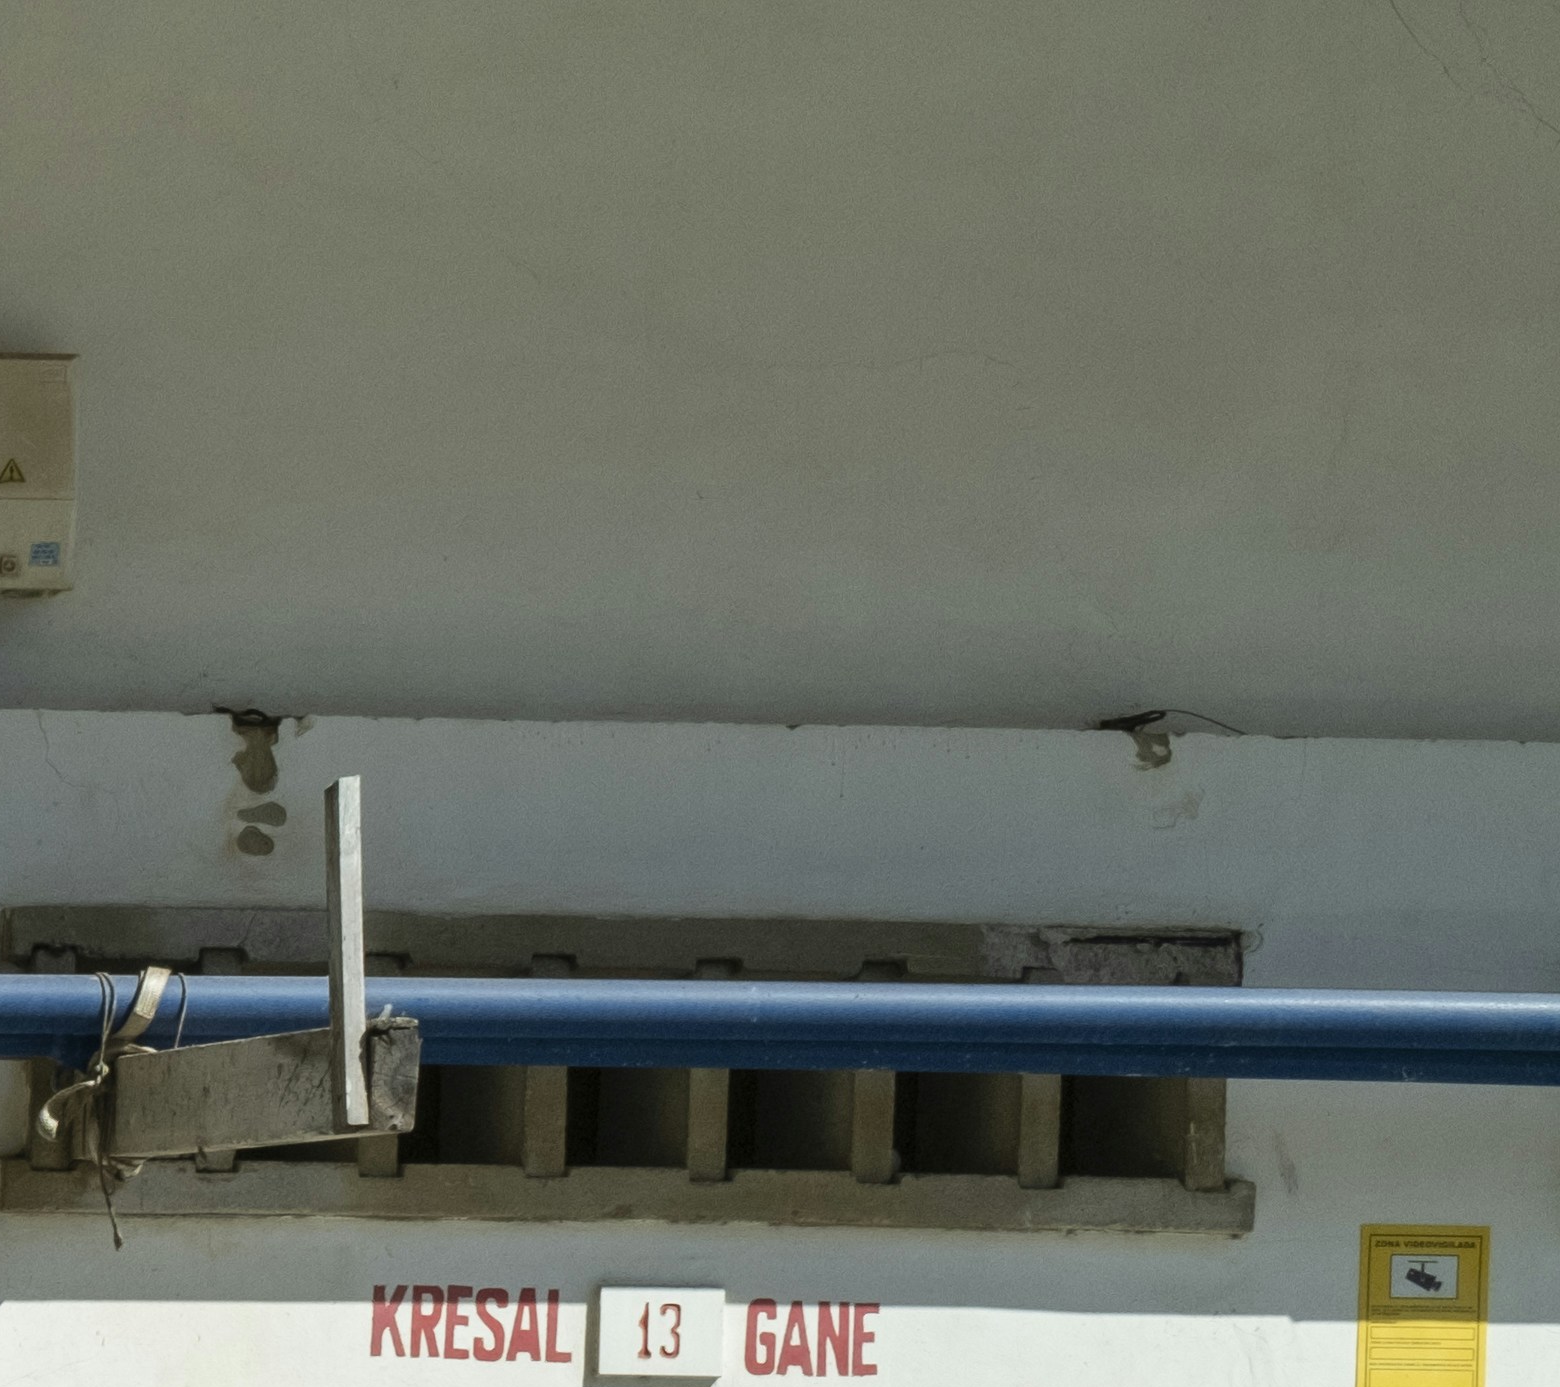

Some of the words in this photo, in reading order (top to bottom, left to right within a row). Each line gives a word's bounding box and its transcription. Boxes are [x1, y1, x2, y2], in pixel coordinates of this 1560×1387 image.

[370, 1285, 572, 1363] KRESAL
[744, 1297, 880, 1377] GANE
[637, 1302, 683, 1359] 13
